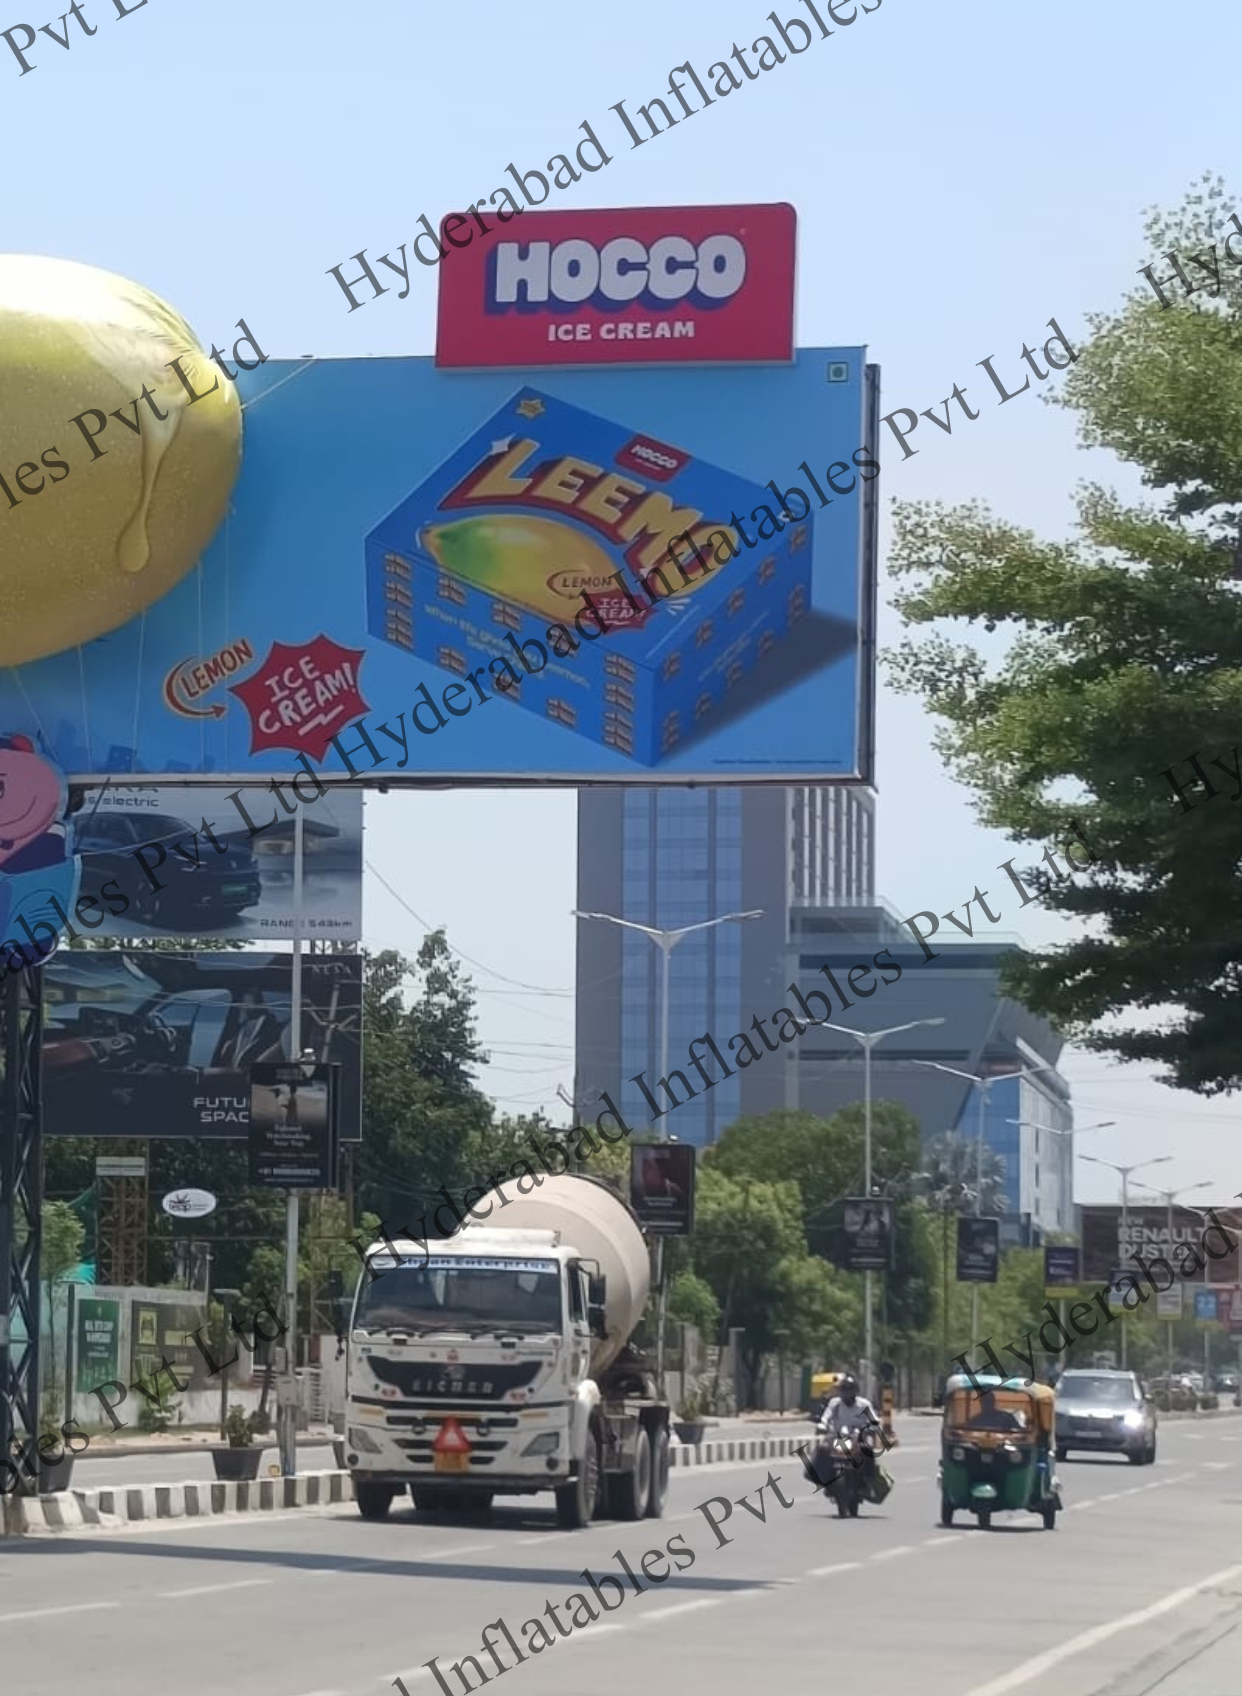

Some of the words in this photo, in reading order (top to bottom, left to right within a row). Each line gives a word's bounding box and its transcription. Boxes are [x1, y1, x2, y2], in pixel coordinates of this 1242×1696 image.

[485, 234, 746, 316] HOCCO
[547, 324, 592, 341] ICE
[599, 321, 695, 340] CREAM
[631, 445, 677, 470] HOCCO
[437, 438, 738, 598] LEEMO
[562, 576, 612, 589] LEMON
[179, 638, 253, 698] LEMON
[265, 656, 320, 702] ICE
[259, 662, 356, 734] CREAM!
[102, 796, 159, 807] electric
[1117, 1227, 1204, 1243] RENAULT
[412, 1380, 493, 1393] EICHER
